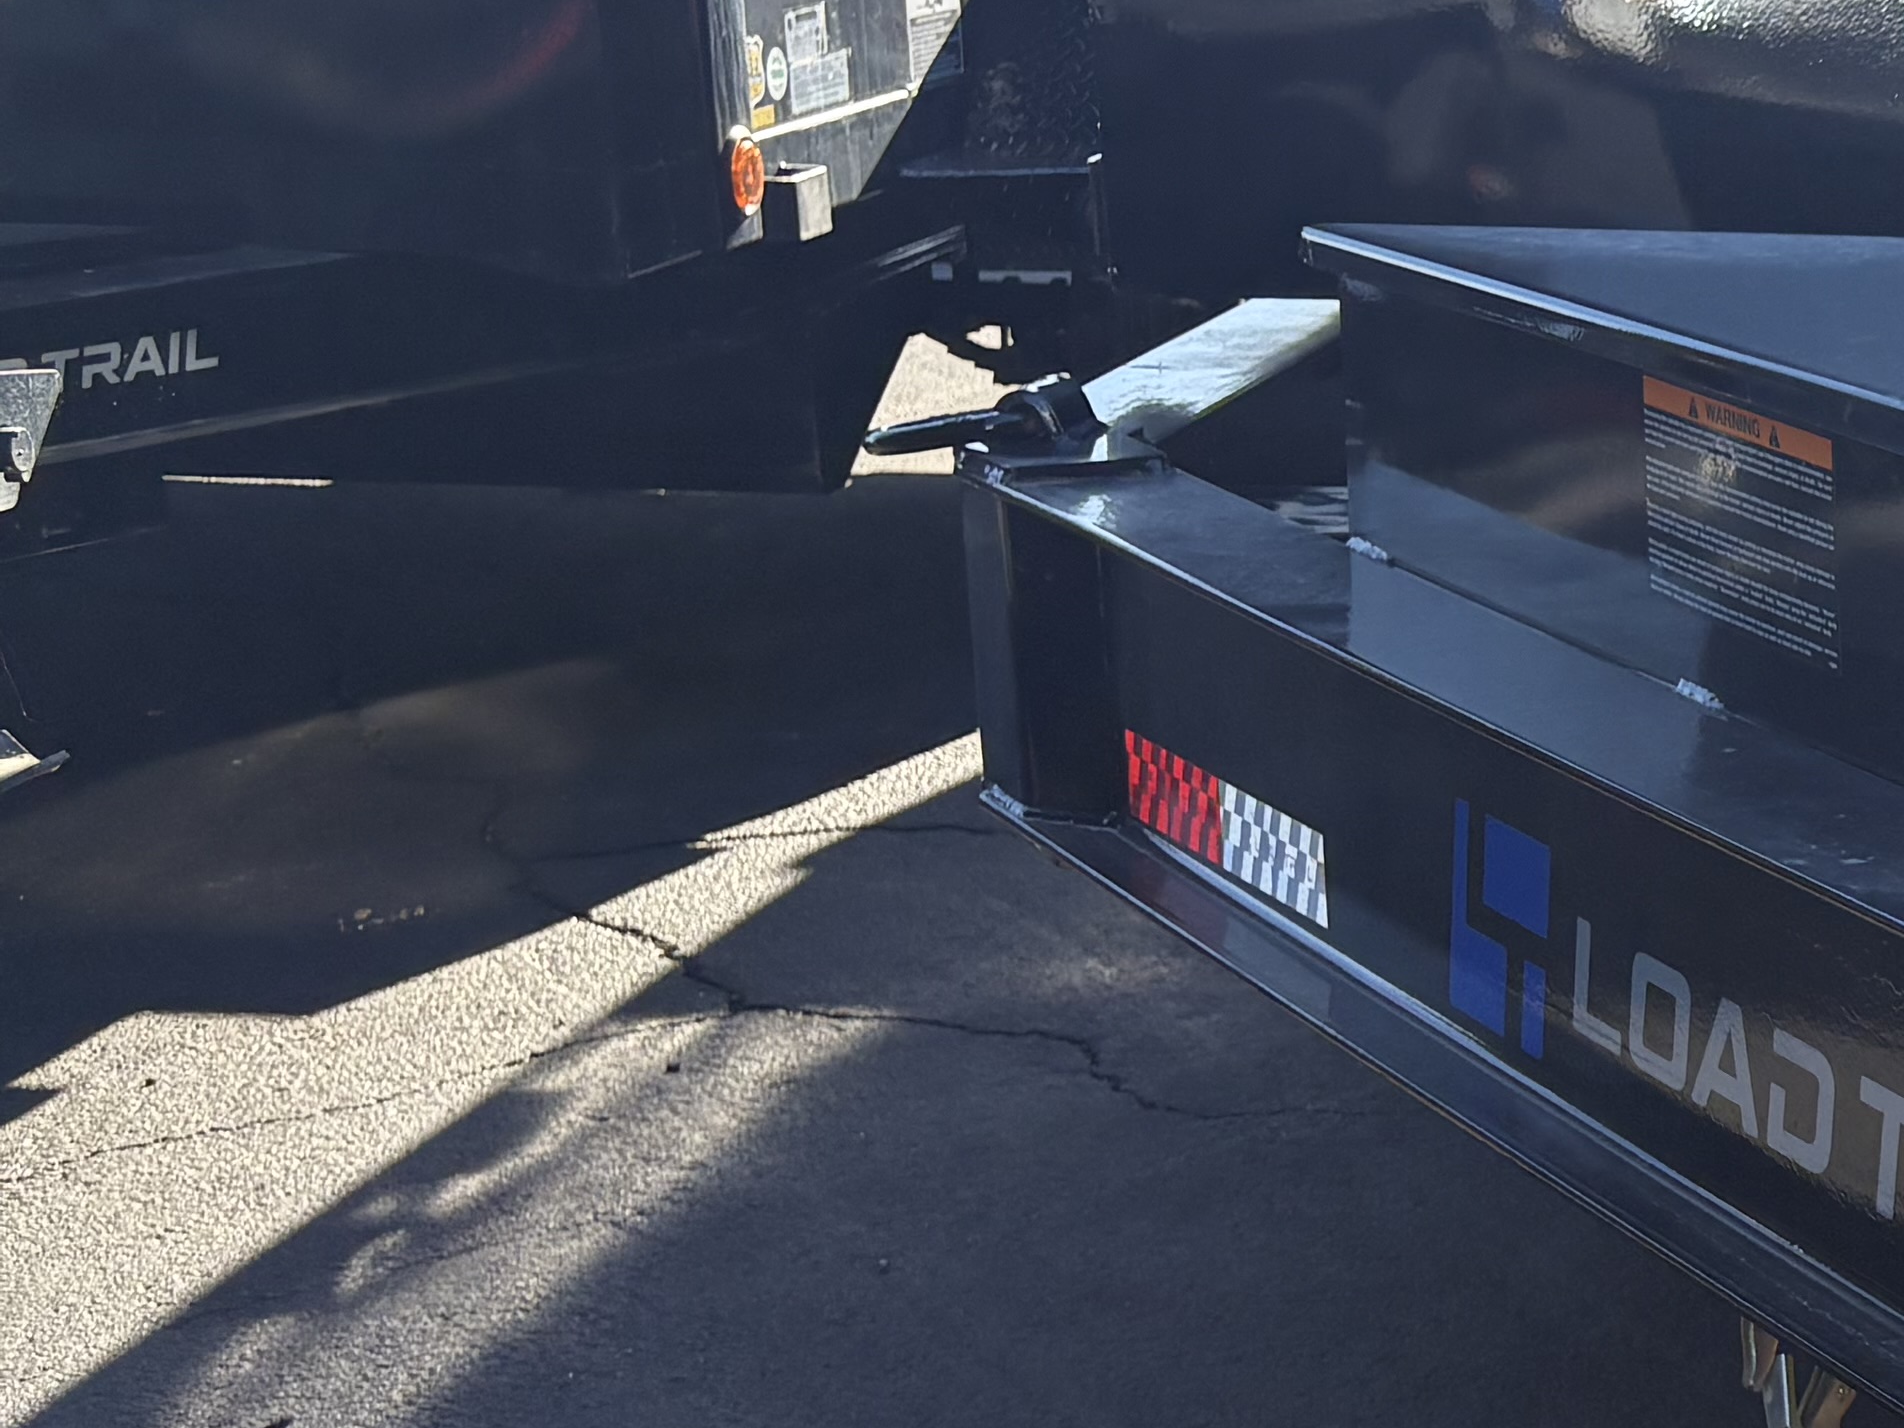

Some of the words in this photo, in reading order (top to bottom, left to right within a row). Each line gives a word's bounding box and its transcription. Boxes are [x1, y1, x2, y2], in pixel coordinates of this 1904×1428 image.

[41, 328, 219, 390] TRAIL
[1705, 403, 1761, 440] WARNING
[1571, 915, 1836, 1175] LOAD
